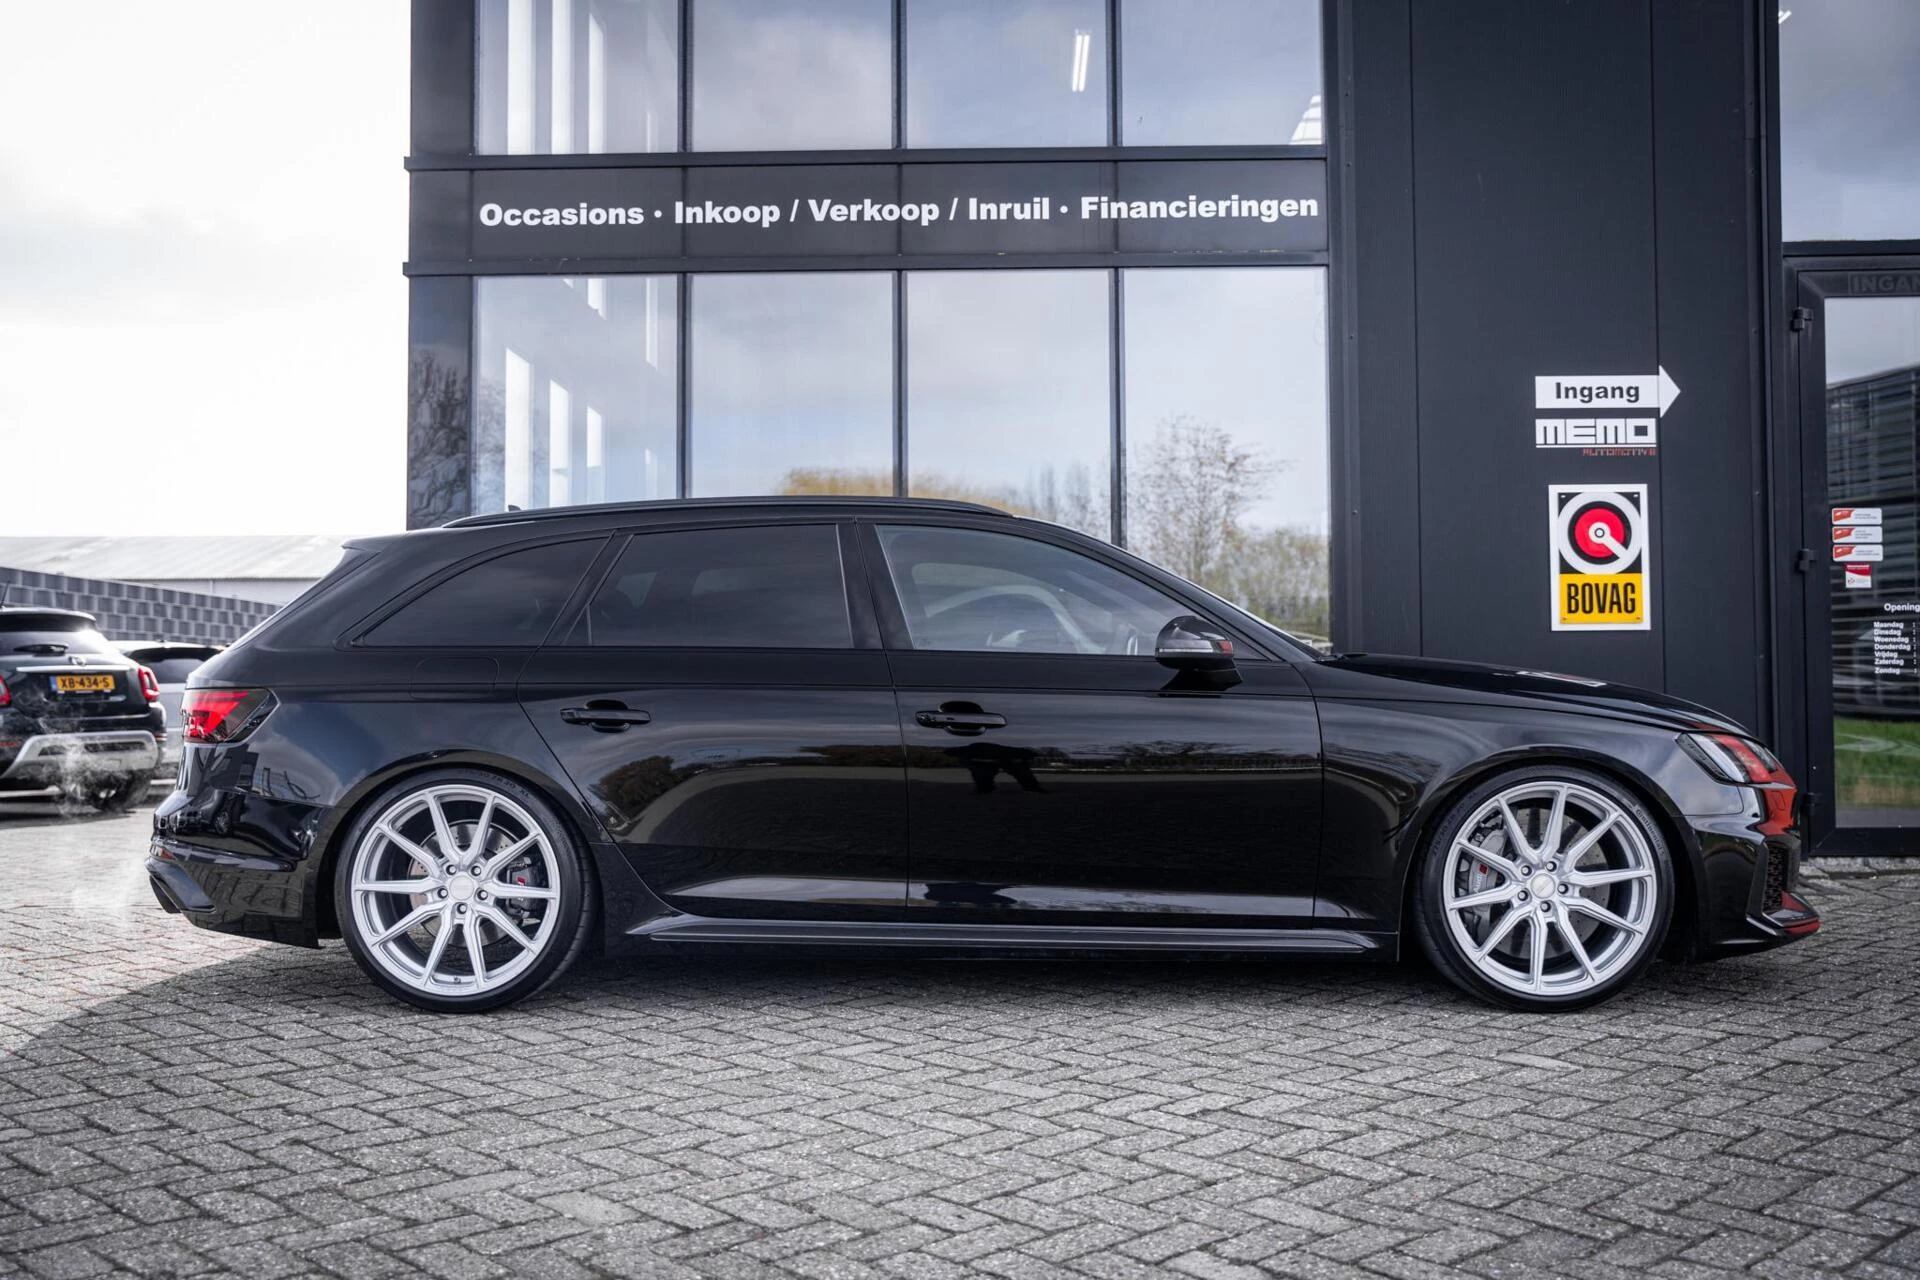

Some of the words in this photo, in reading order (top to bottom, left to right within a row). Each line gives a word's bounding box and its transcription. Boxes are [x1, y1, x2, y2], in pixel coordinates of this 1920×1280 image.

[480, 203, 645, 226] Occasions
[675, 201, 781, 227] Inkoop
[808, 199, 940, 226] Verkoop
[968, 197, 1050, 220] Inruil
[1080, 194, 1319, 223] Financieringen
[1555, 382, 1640, 404] Ingang
[1535, 418, 1657, 446] MEMO
[1567, 582, 1636, 614] BOVAG
[1873, 621, 1904, 629] Maandag
[1873, 636, 1909, 644] Woensdag
[1874, 643, 1911, 651] Donderdag
[1874, 651, 1899, 659] Vrijdag
[1874, 658, 1905, 666] Zaterdag
[1874, 667, 1901, 675] Zondag
[60, 676, 110, 689] XB-434-S
